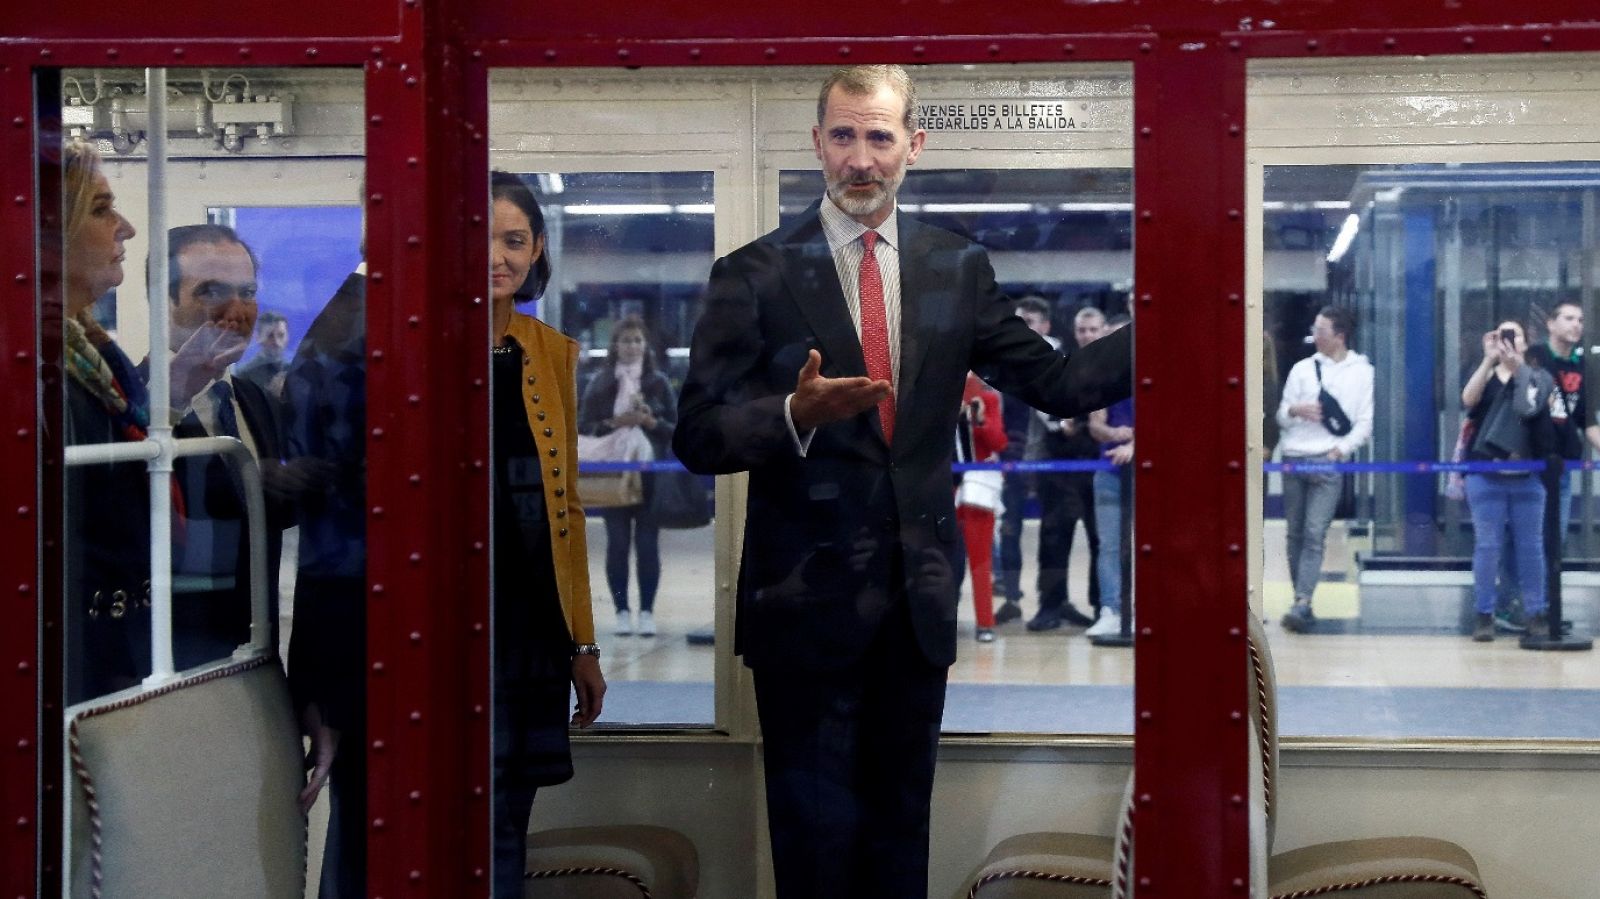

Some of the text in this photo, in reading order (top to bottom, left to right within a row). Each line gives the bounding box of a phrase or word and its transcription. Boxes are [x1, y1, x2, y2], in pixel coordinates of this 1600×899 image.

[918, 104, 1063, 117] VENSE LOS BILLETES
[993, 117, 1002, 129] A
[1007, 117, 1023, 129] LA
[1028, 117, 1076, 129] SALIDA
